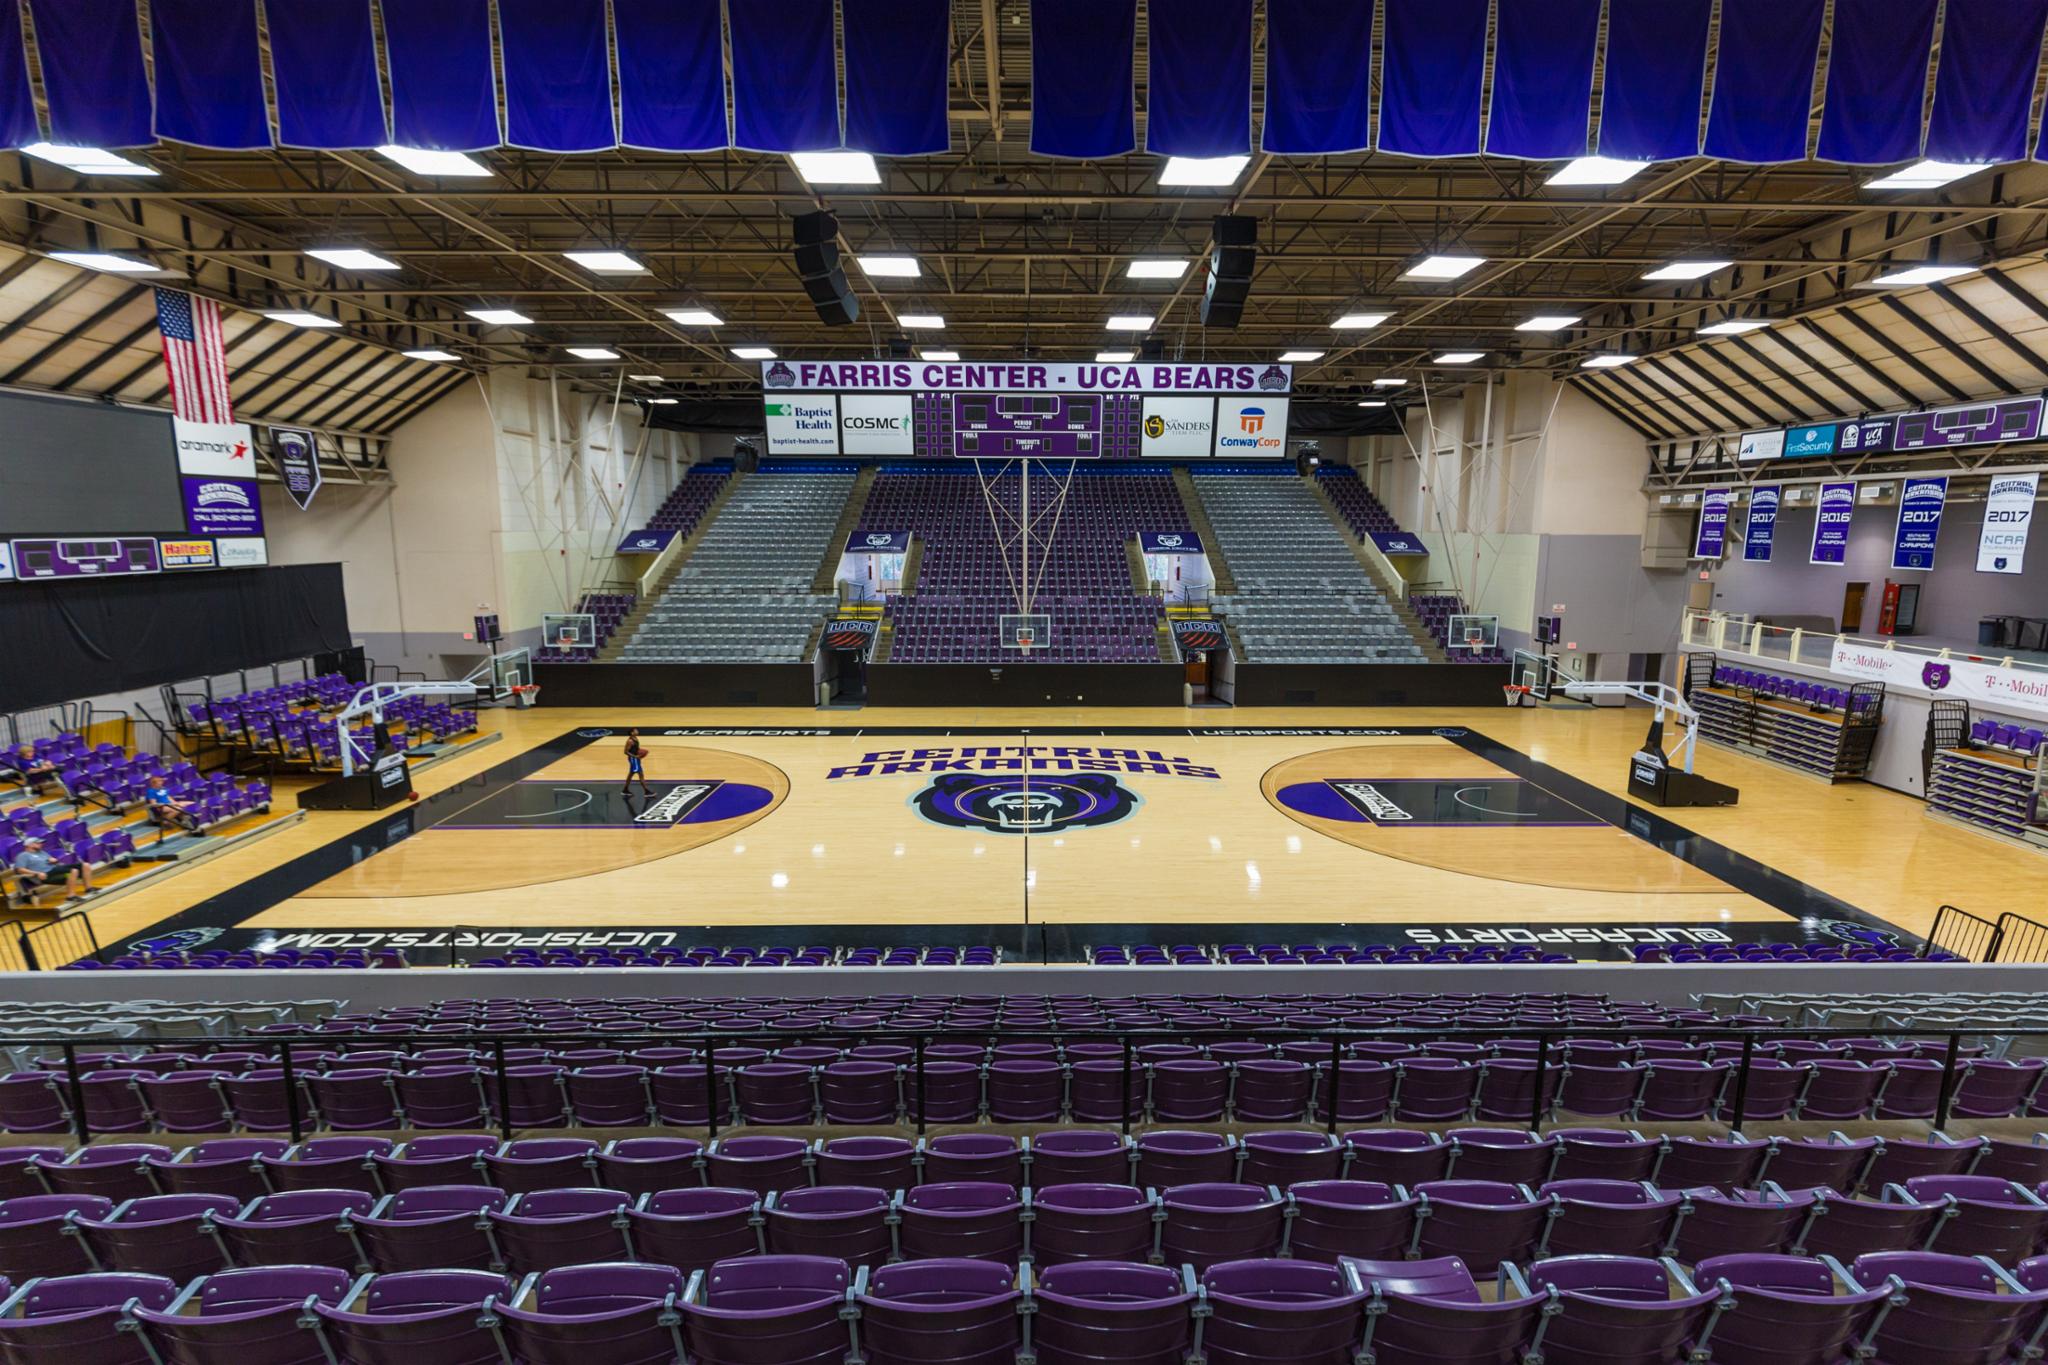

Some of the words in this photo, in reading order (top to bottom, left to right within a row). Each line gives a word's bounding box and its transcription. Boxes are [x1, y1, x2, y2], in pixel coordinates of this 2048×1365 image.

[800, 364, 912, 388] FARRIS
[922, 364, 1047, 388] CENTER
[1077, 366, 1142, 389] UCA
[1153, 366, 1254, 390] BEARS
[795, 407, 833, 419] Baptist
[795, 419, 832, 430] Health
[843, 417, 900, 430] COSMC
[1165, 421, 1210, 431] SANDERS
[180, 440, 232, 453] aramark
[1220, 436, 1281, 448] ConwayCorp
[1907, 484, 1943, 493] CENTRAL
[1994, 480, 2033, 489] CENTRAL
[1905, 490, 1944, 500] ARKANSAS
[1991, 486, 2035, 497] ARKANSAS
[1703, 513, 1727, 522] 2012
[1751, 513, 1776, 522] 2017
[1820, 512, 1850, 522] 2016
[1903, 511, 1940, 522] 2017
[1988, 511, 2029, 523] 2017
[1984, 535, 2025, 545] NCAA
[828, 621, 875, 633] UCA
[1174, 622, 1221, 634] UCA
[860, 746, 1190, 764] CENTRAL
[826, 758, 1222, 779] ARKANSAS
[276, 932, 677, 948] UCASPORTS.COM
[1405, 927, 1733, 943] @UCASPORTS
